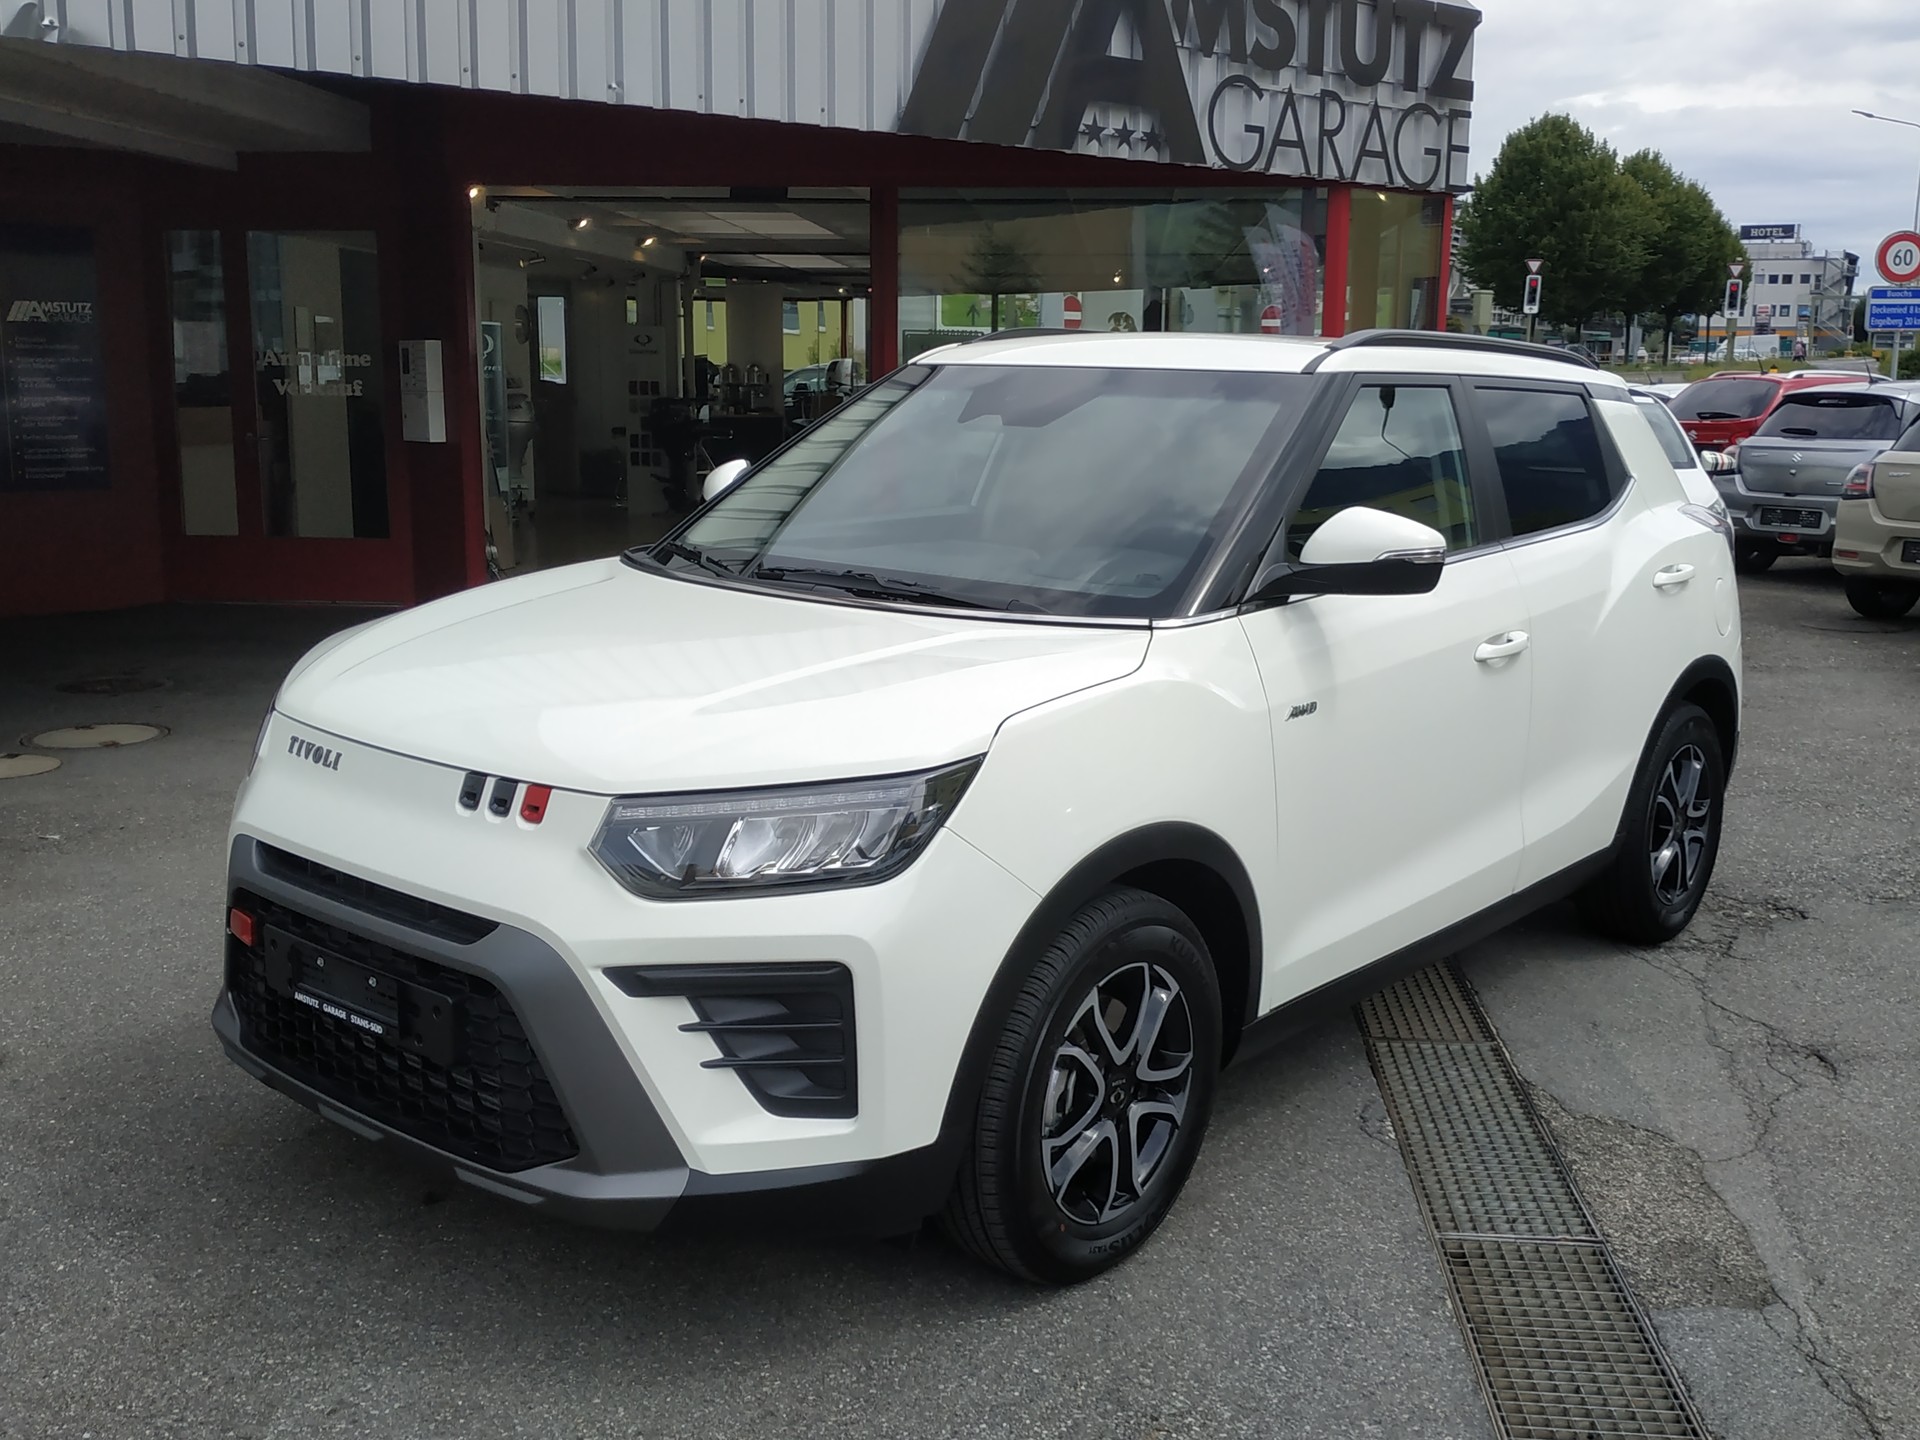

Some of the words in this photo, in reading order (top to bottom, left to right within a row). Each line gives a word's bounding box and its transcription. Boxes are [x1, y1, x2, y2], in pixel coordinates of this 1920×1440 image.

[1028, 0, 1482, 164] AMSTUTZ
[1208, 74, 1472, 192] GARAGE
[1750, 227, 1785, 237] HOTEL
[1893, 249, 1913, 267] 60
[1886, 290, 1912, 298] Buochs
[24, 300, 92, 321] AMSTUTZ
[1871, 305, 1908, 315] Beckenried
[1909, 305, 1914, 314] 8
[1870, 316, 1903, 328] Engelberg
[1904, 316, 1914, 326] 20
[263, 348, 372, 367] Annahme
[288, 735, 343, 771] TIVOLI
[294, 991, 320, 1009] AMSTUTZ
[322, 1003, 347, 1020] GARAGE
